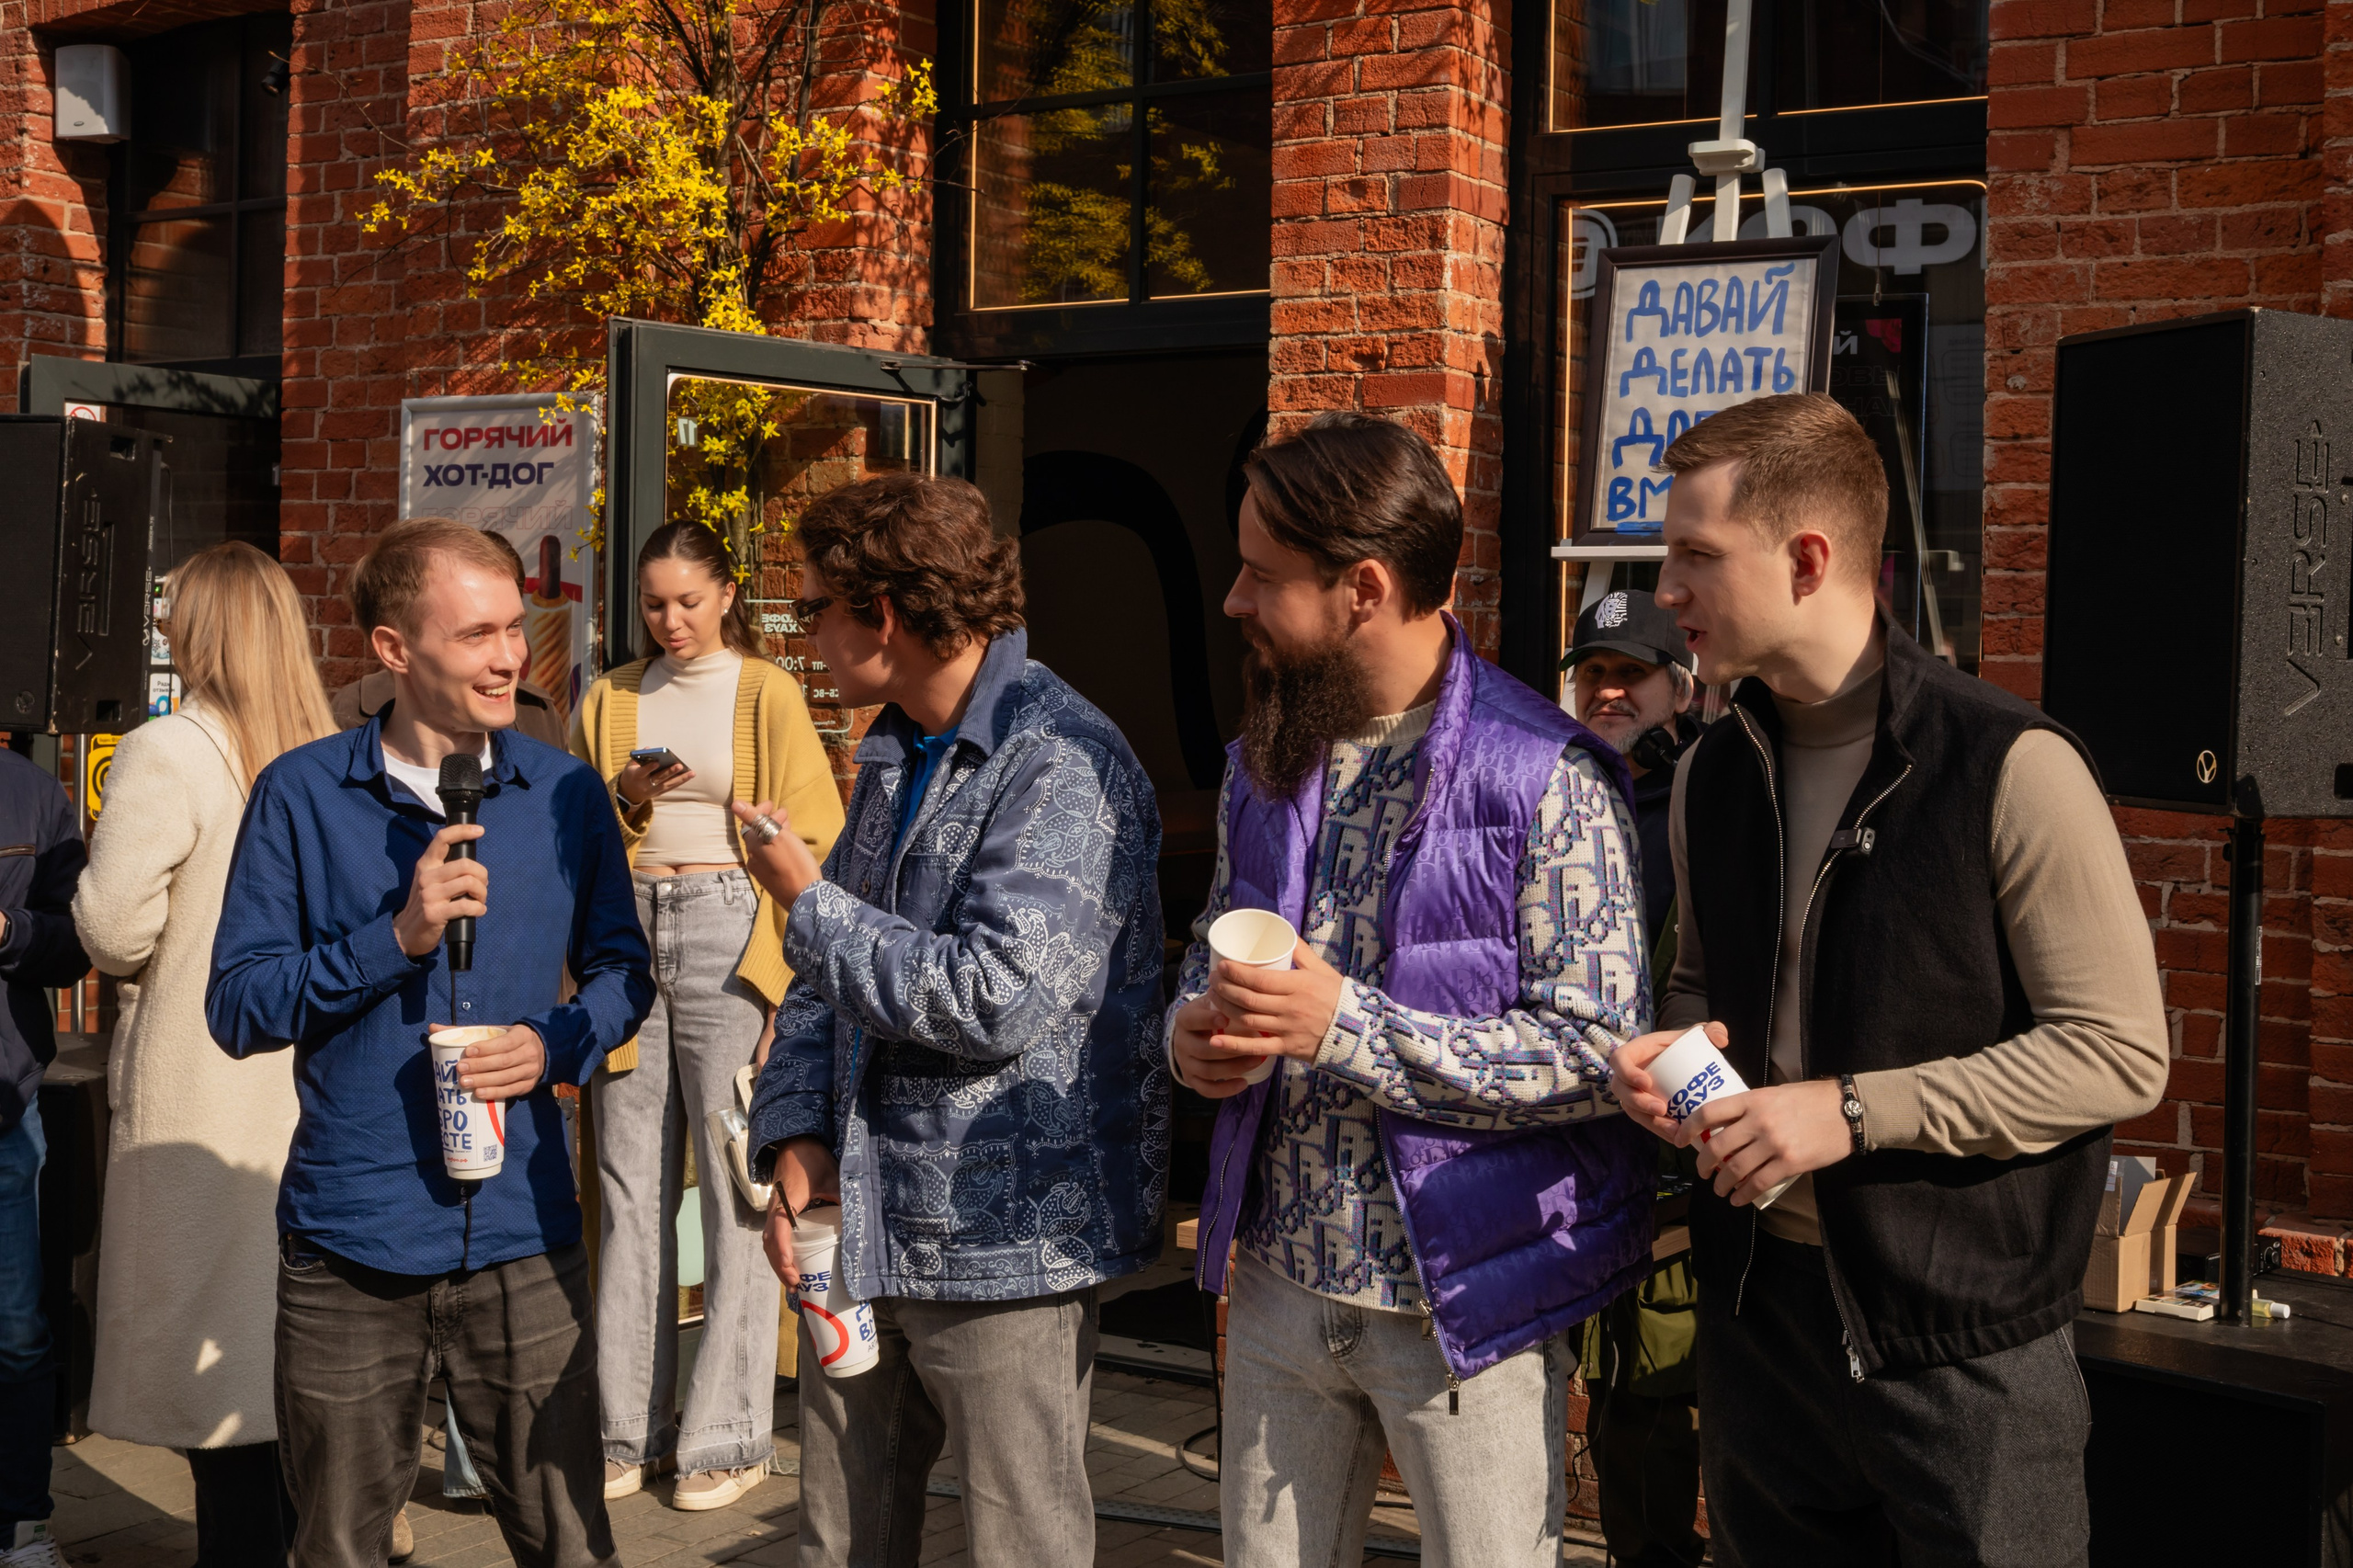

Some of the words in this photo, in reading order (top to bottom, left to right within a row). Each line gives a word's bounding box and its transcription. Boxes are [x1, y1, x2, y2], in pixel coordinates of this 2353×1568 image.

[1626, 262, 1795, 343] ДАВАЙ
[1620, 347, 1795, 398] ДЕЛАТЬ
[424, 418, 573, 450] ГОРЯЧИЙ
[423, 462, 554, 489] ХОТ-ДОГ
[1607, 475, 1675, 522] ВМ
[435, 1060, 459, 1085] АЙ
[438, 1089, 467, 1106] АТЬ
[1665, 1061, 1722, 1116] КОФЕ
[1673, 1074, 1725, 1125] ХАУЗ
[438, 1110, 468, 1131] БРО
[442, 1133, 472, 1150] СТЕ
[797, 1282, 829, 1292] АУЗ
[799, 1270, 832, 1283] ФЕ
